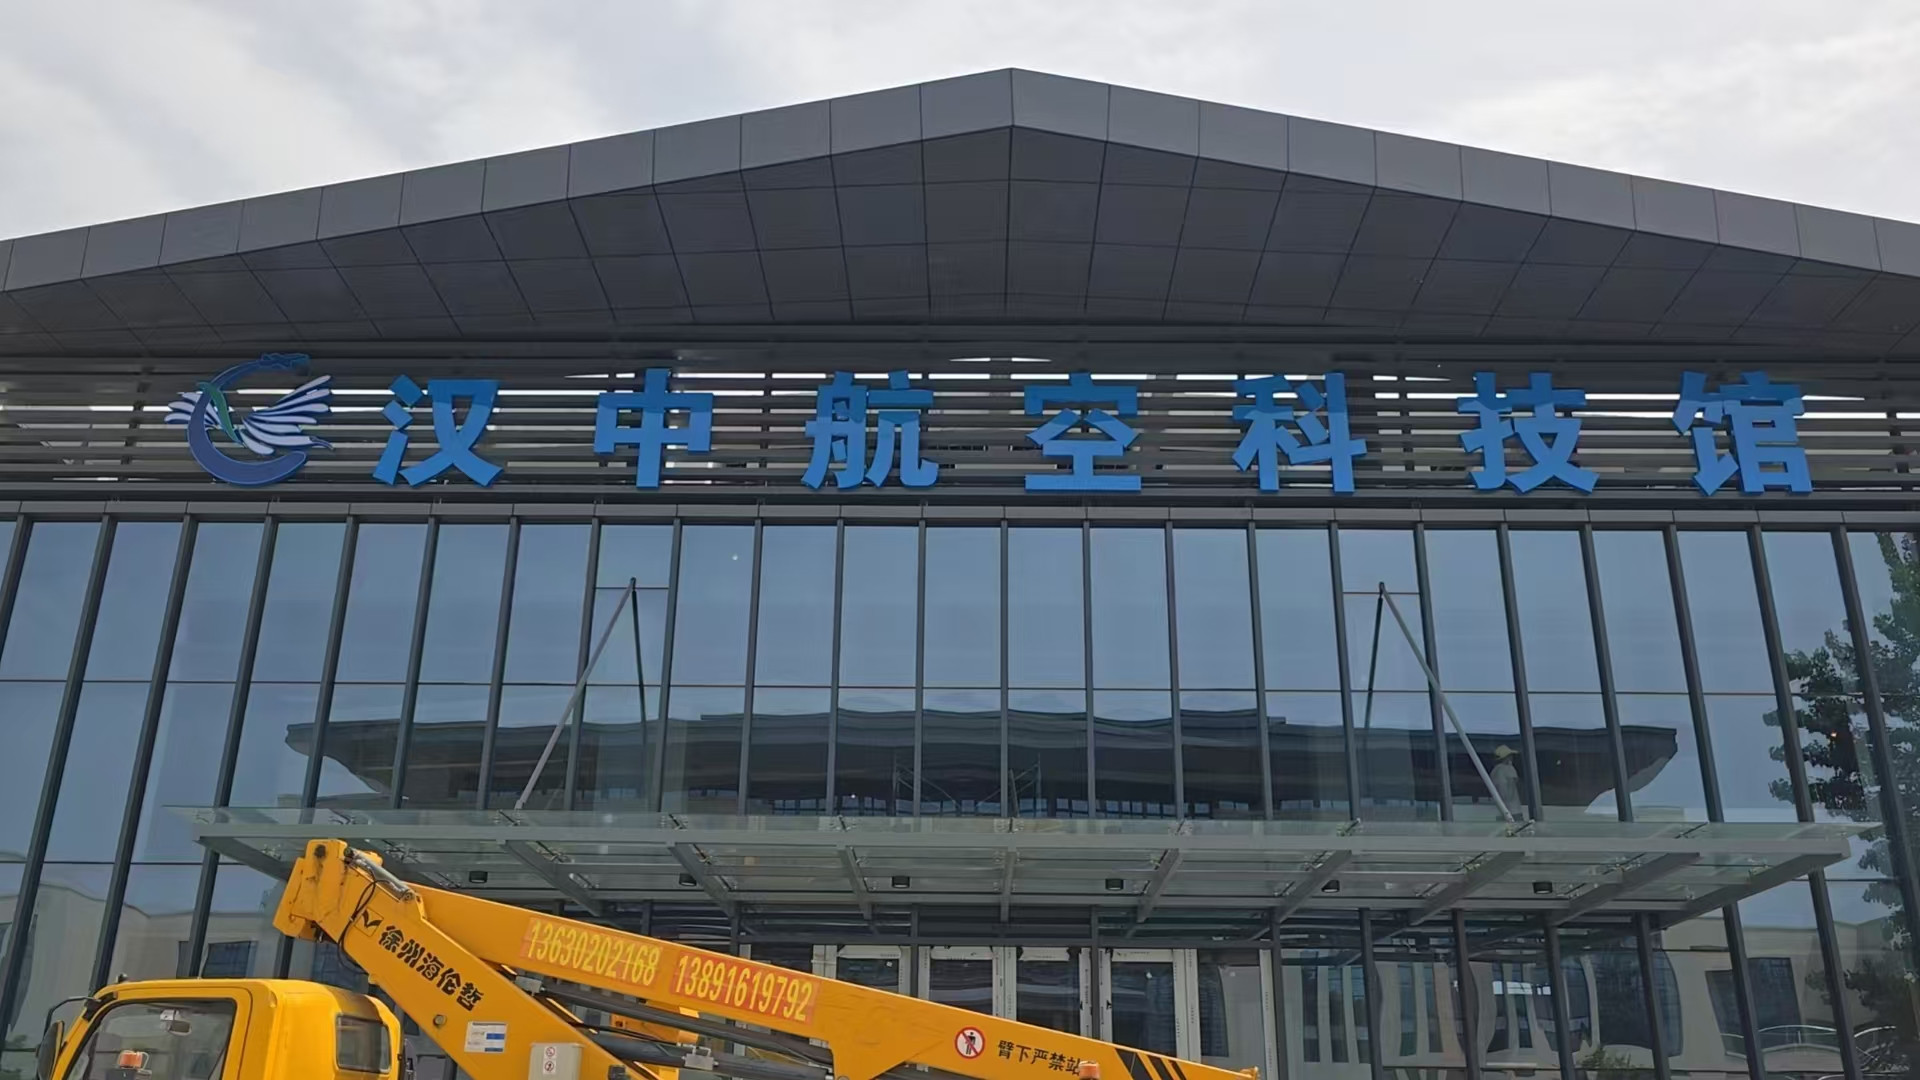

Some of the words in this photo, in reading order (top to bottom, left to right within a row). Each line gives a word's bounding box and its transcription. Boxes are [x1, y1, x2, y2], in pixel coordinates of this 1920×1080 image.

[373, 366, 1812, 495] 汉中航空科技馆
[379, 925, 484, 1011] 徐州海伦哲
[527, 919, 661, 987] 13630202168
[675, 954, 813, 1022] 13891619792
